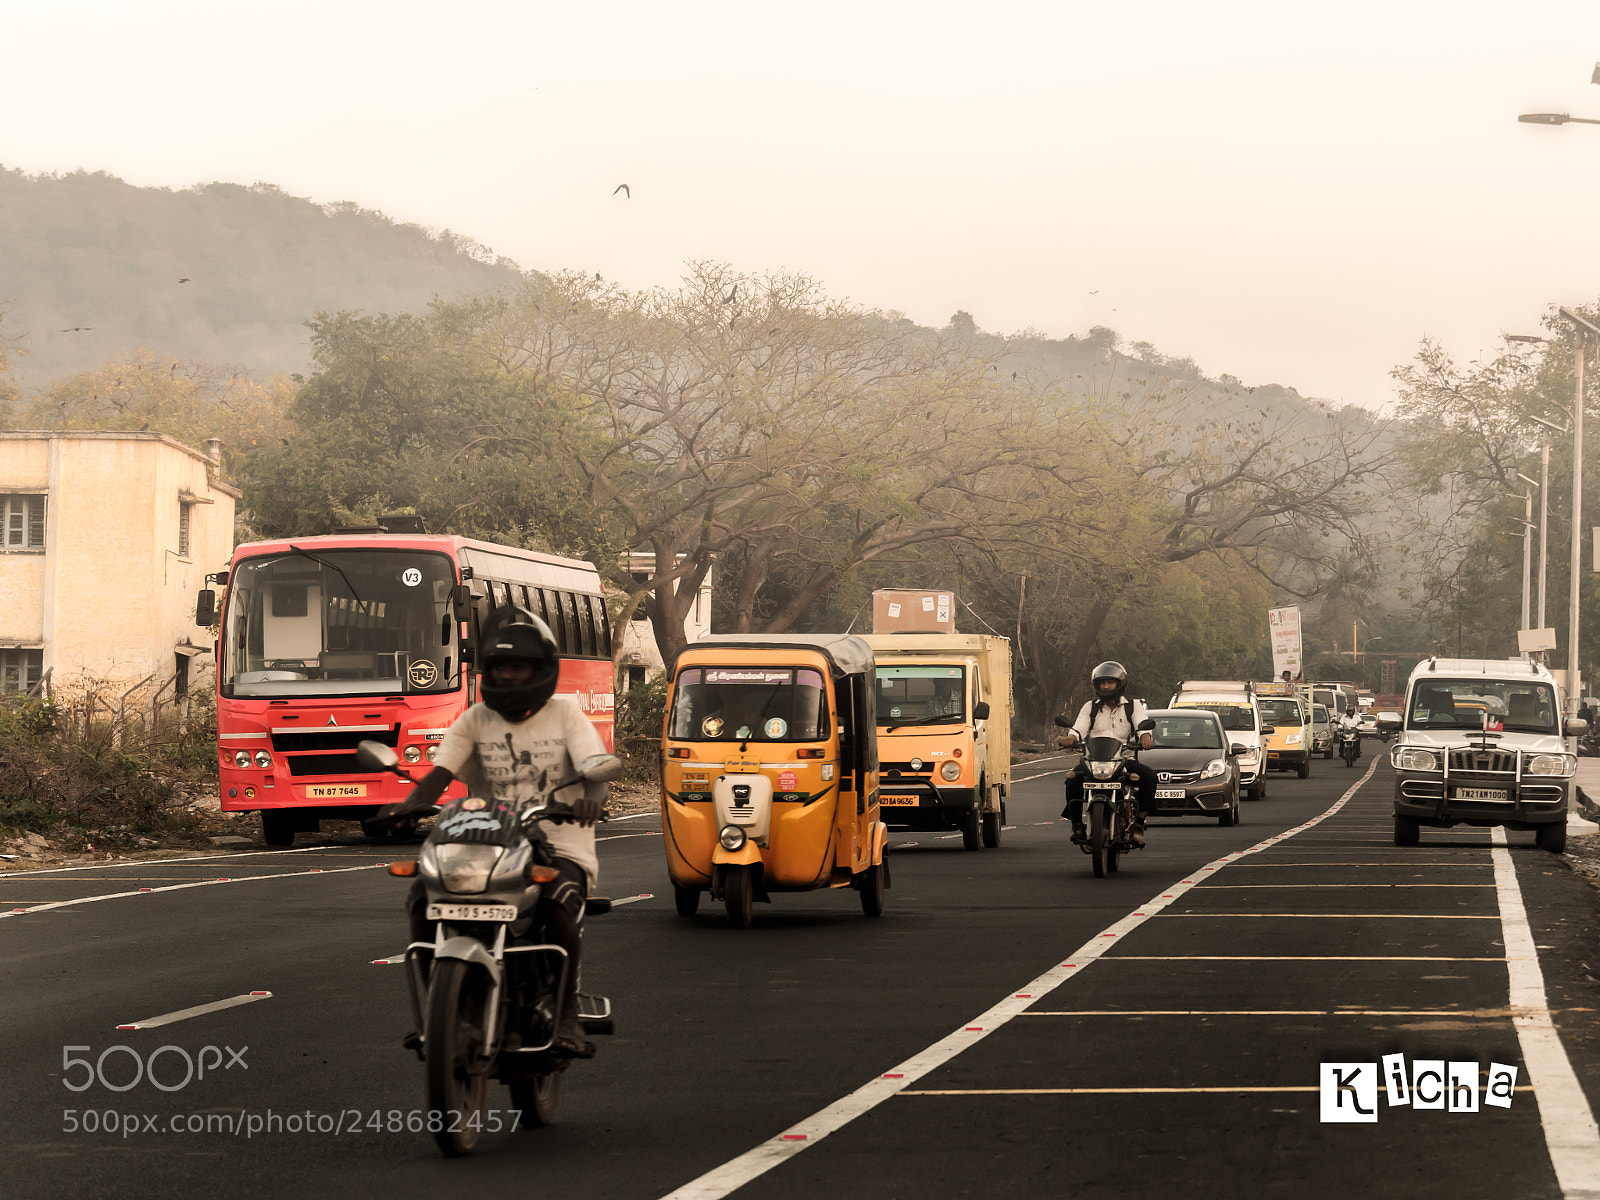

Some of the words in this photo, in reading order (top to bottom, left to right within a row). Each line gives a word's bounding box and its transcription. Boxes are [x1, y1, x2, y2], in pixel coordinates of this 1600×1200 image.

[405, 572, 419, 582] V3
[312, 788, 325, 796] TN
[327, 788, 337, 796] 87
[338, 787, 359, 795] 7645
